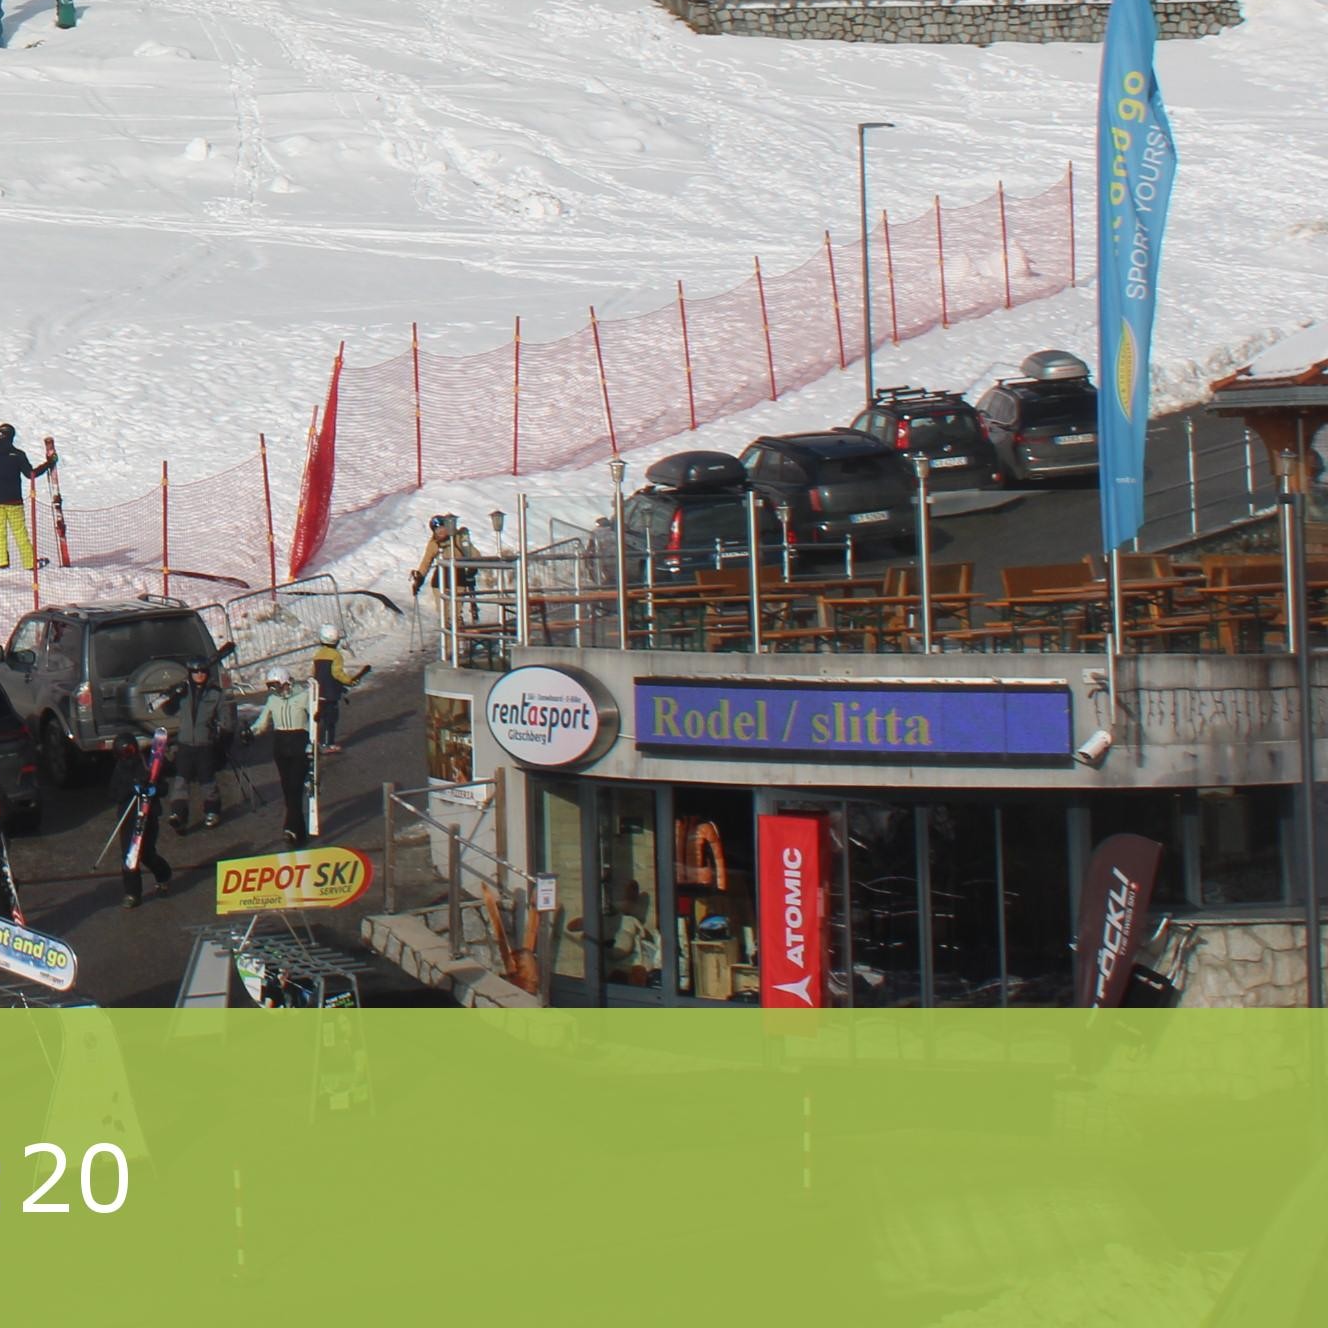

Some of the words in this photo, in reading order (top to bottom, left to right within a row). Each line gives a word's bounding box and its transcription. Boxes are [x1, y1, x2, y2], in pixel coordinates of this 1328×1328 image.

[1118, 70, 1145, 123] go
[652, 696, 769, 741] Rodel
[811, 702, 934, 746] slitta
[222, 864, 311, 894] DEPOT
[313, 860, 360, 888] SKI
[319, 885, 352, 896] SERVICE
[782, 847, 805, 969] ATOMIC
[12, 936, 46, 960] and
[46, 947, 67, 968] go
